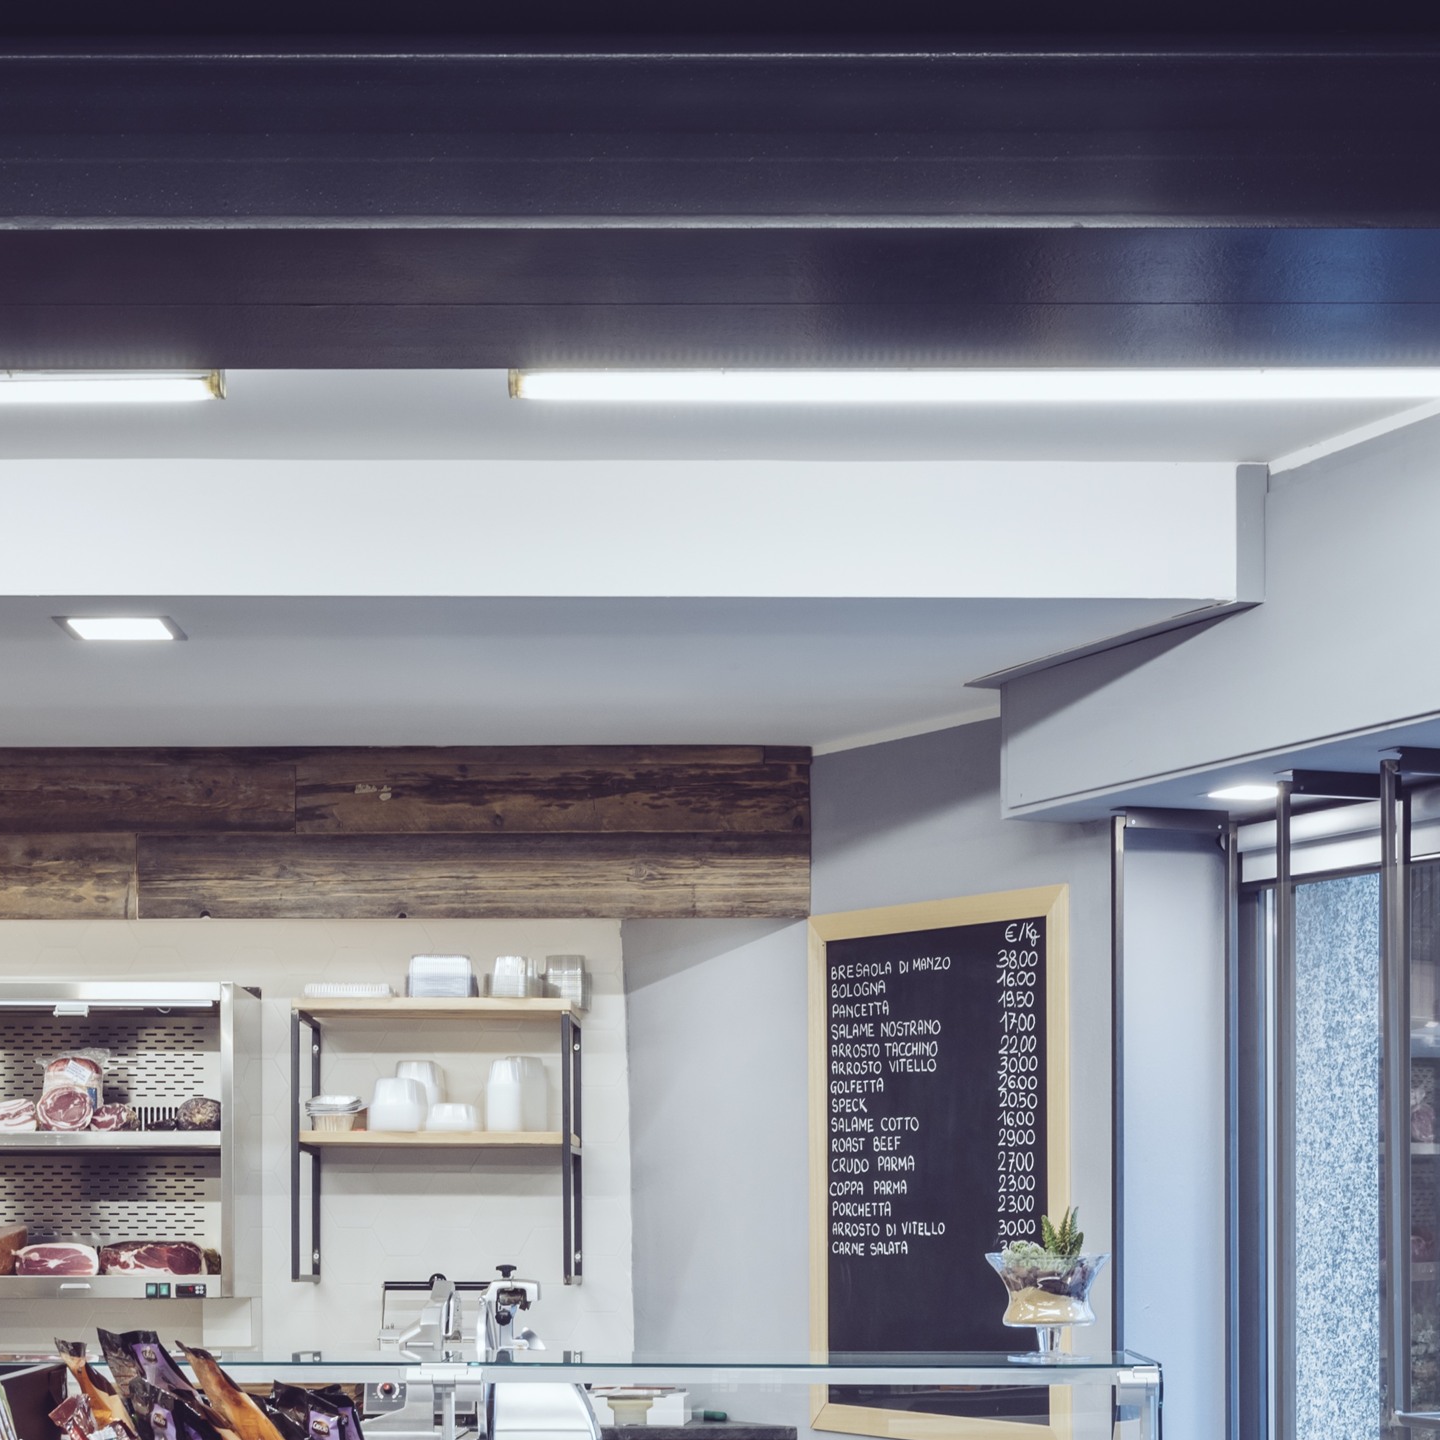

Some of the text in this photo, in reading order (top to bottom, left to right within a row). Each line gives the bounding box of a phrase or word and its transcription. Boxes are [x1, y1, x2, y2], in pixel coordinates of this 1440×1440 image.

[831, 962, 892, 981] BRESAOLA
[899, 960, 908, 973] DI
[913, 956, 951, 972] MANZO
[831, 980, 886, 998] BOLOGNA
[832, 1001, 890, 1018] PANCETTA
[831, 1020, 875, 1039] SALAME
[880, 1020, 941, 1037] NOSTRANO
[831, 1042, 881, 1057] ARROSTO
[885, 1041, 938, 1057] TACCHINO
[831, 1061, 882, 1075] ARROSTO
[890, 1059, 937, 1073] VITELLO
[830, 1078, 884, 1094] GOLFETTA
[832, 1098, 868, 1113] SPECK
[831, 1117, 875, 1133] SALAME
[880, 1117, 919, 1132] COTTO
[832, 1137, 865, 1153] ROAST
[873, 1136, 901, 1151] BEEF
[831, 1159, 870, 1173] CRUDO
[878, 1156, 915, 1172] PARMA
[830, 1181, 864, 1197] COPPA
[873, 1180, 908, 1195] PARMA
[832, 1202, 892, 1217] PORCHETTA
[832, 1222, 880, 1236] ARROSTO
[887, 1223, 897, 1235] DI
[901, 1221, 945, 1235] VITELLO
[832, 1240, 908, 1256] CARNE SALATA
